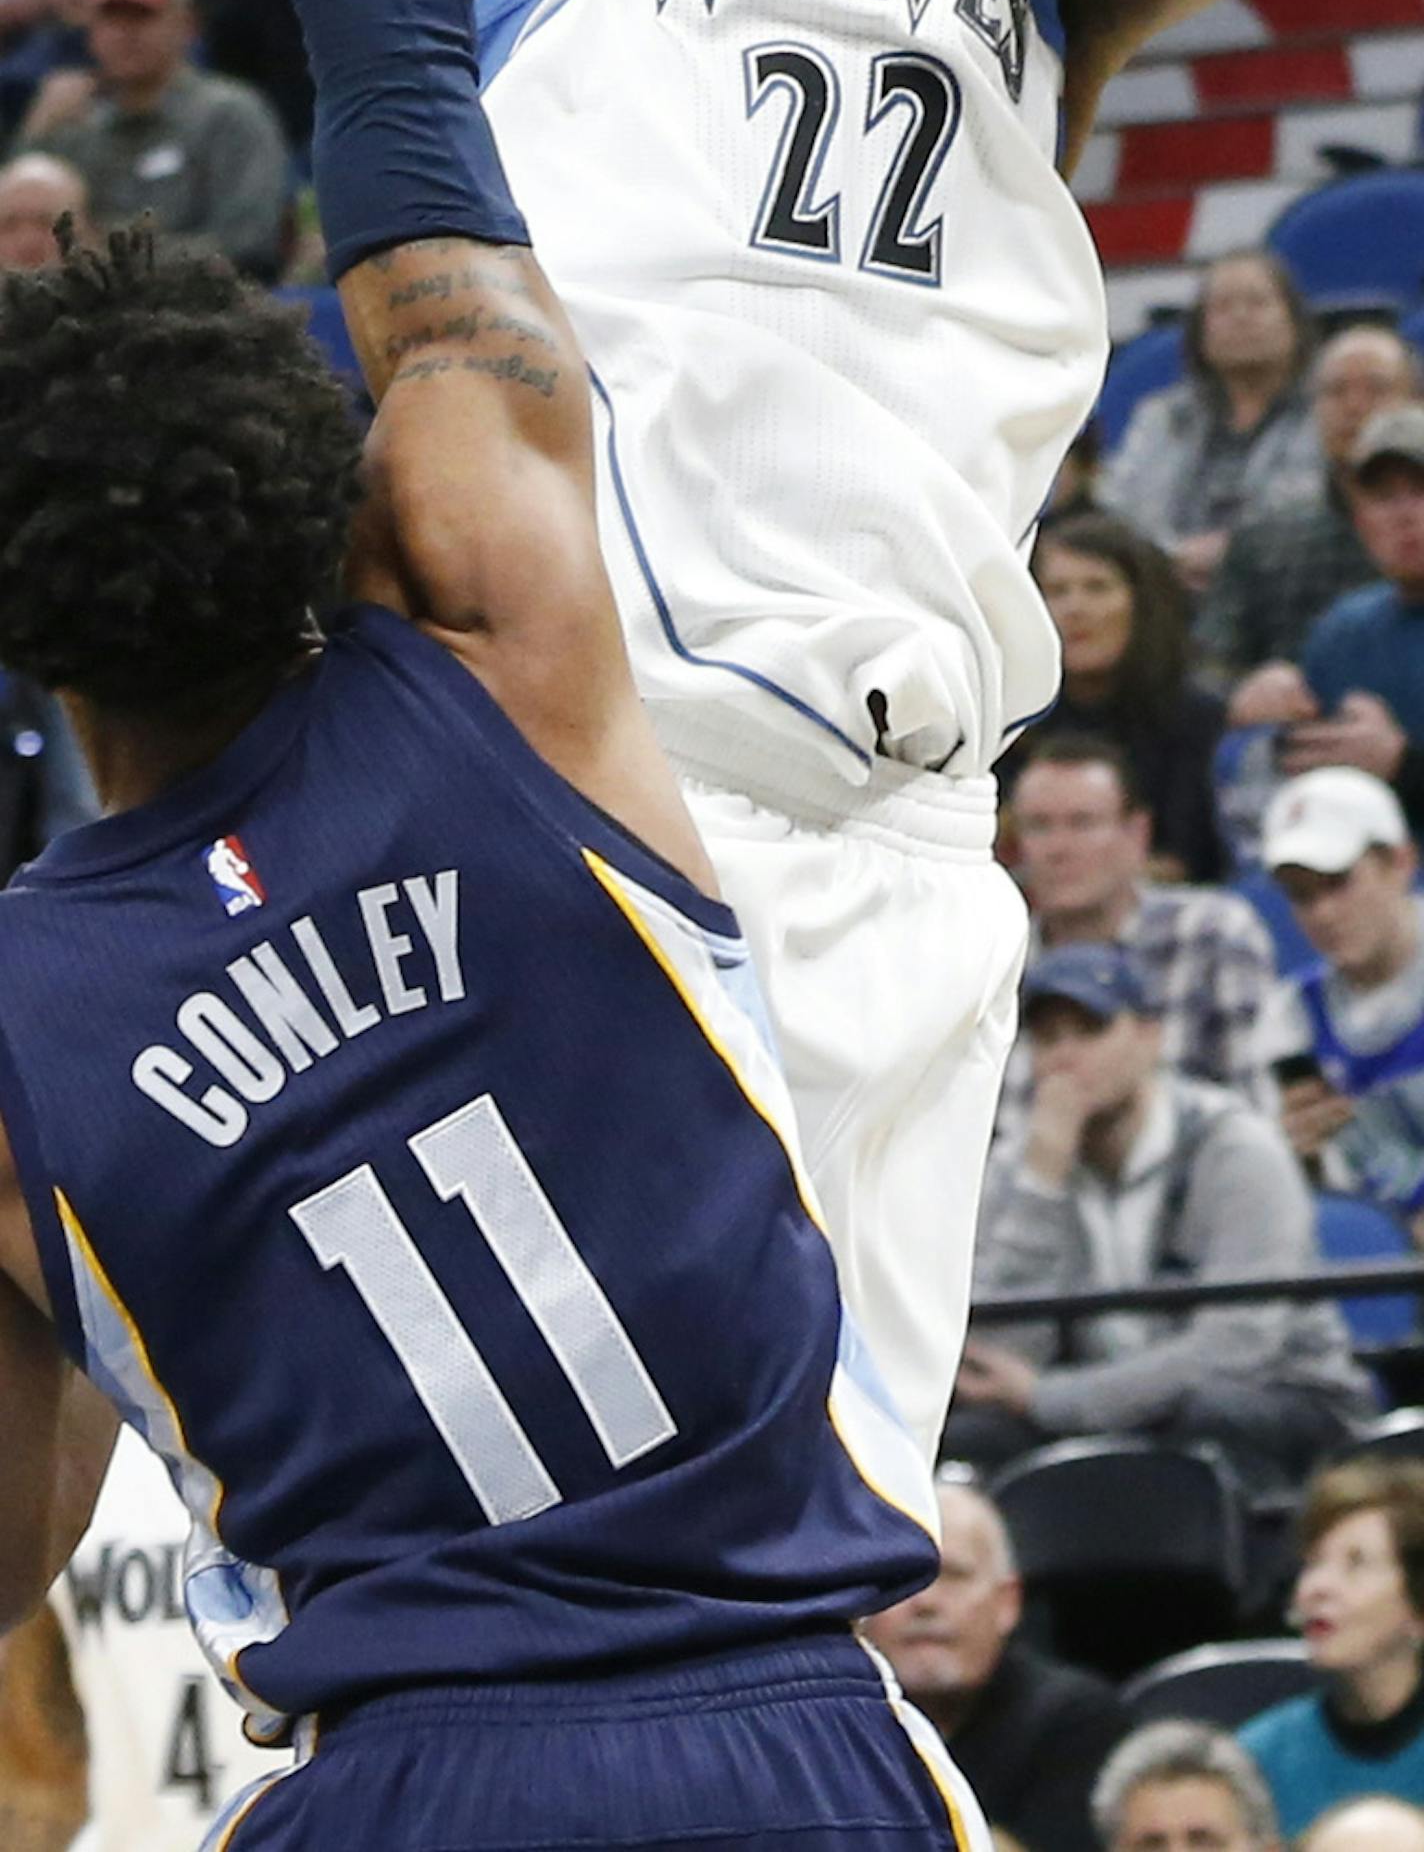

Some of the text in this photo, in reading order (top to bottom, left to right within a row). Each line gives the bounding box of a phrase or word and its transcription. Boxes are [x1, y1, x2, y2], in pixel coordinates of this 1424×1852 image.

[742, 40, 962, 288] 22
[132, 870, 466, 1149] CONLEY
[287, 1091, 679, 1527] 11
[160, 1673, 226, 1811] 4
